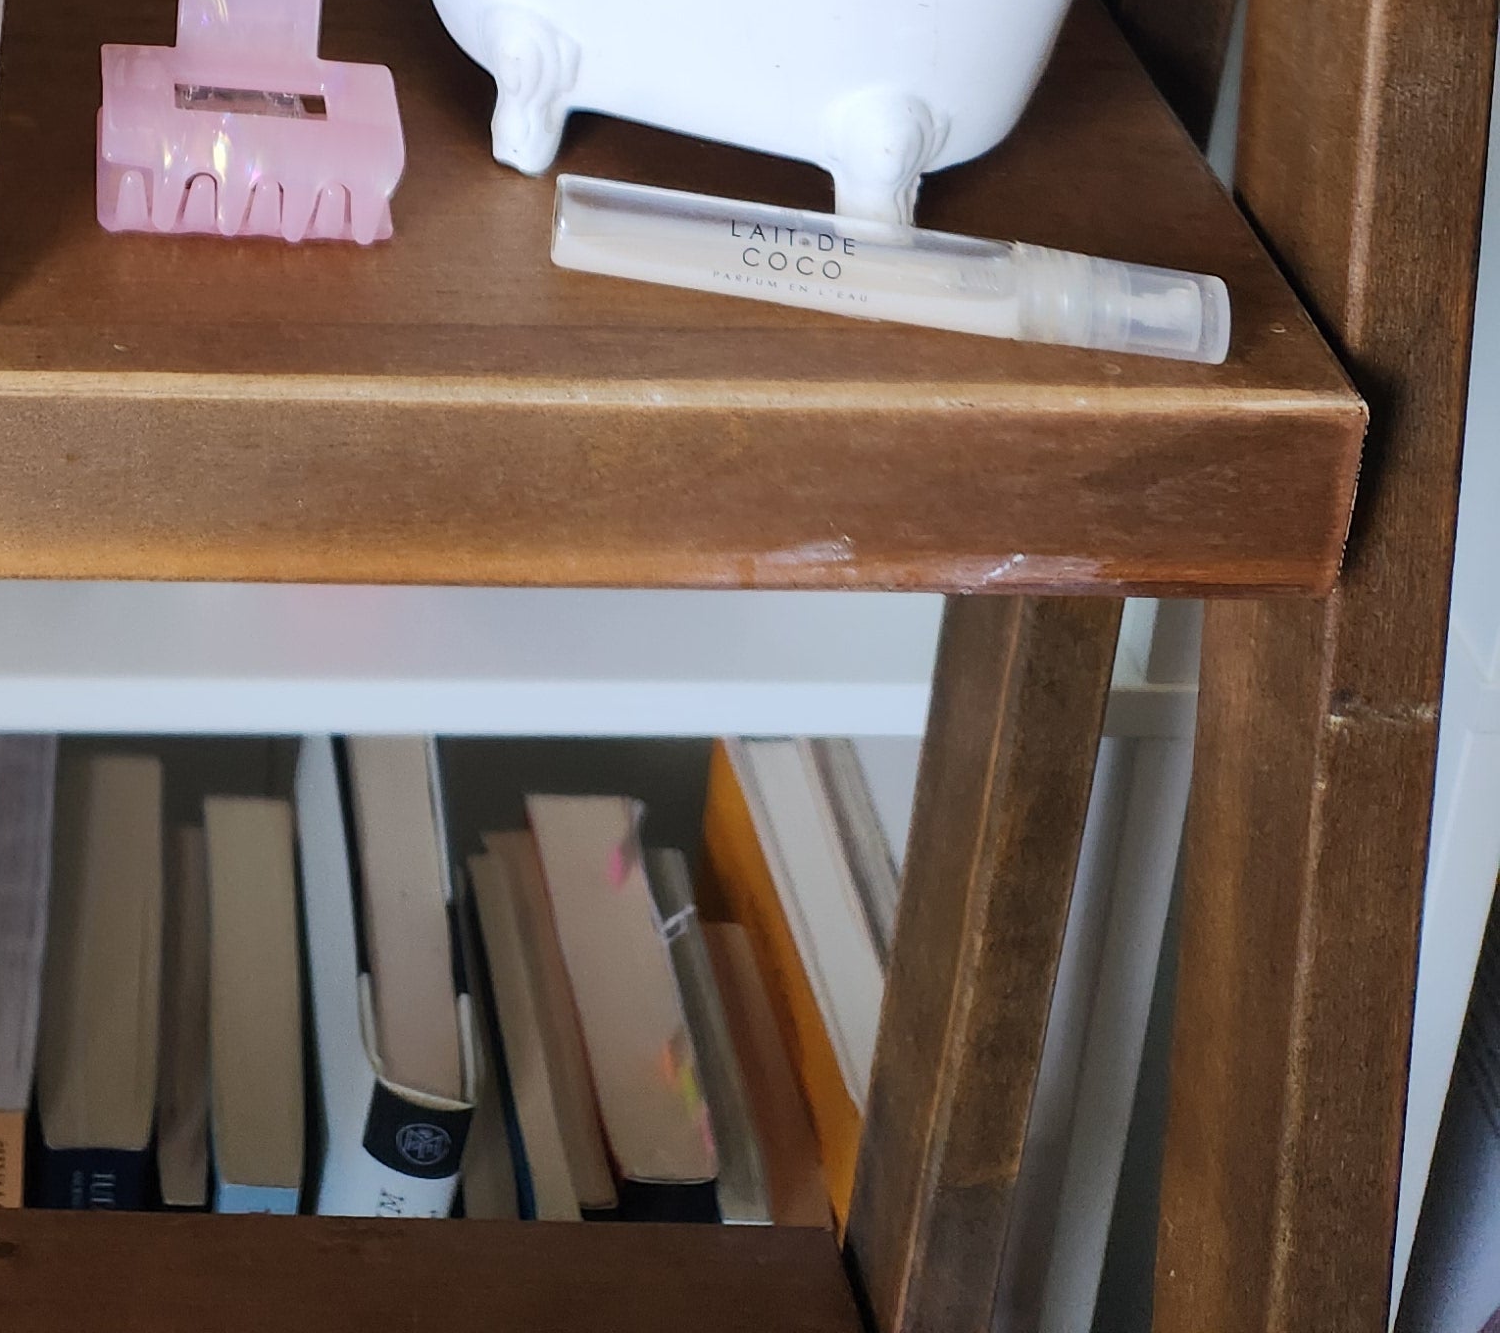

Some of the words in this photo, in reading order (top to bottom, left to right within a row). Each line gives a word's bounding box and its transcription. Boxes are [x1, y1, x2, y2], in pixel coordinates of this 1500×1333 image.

[731, 219, 796, 245] LAIT
[817, 232, 857, 256] DE
[742, 247, 842, 279] COCO
[712, 270, 778, 289] PARFUM
[789, 283, 810, 294] EN
